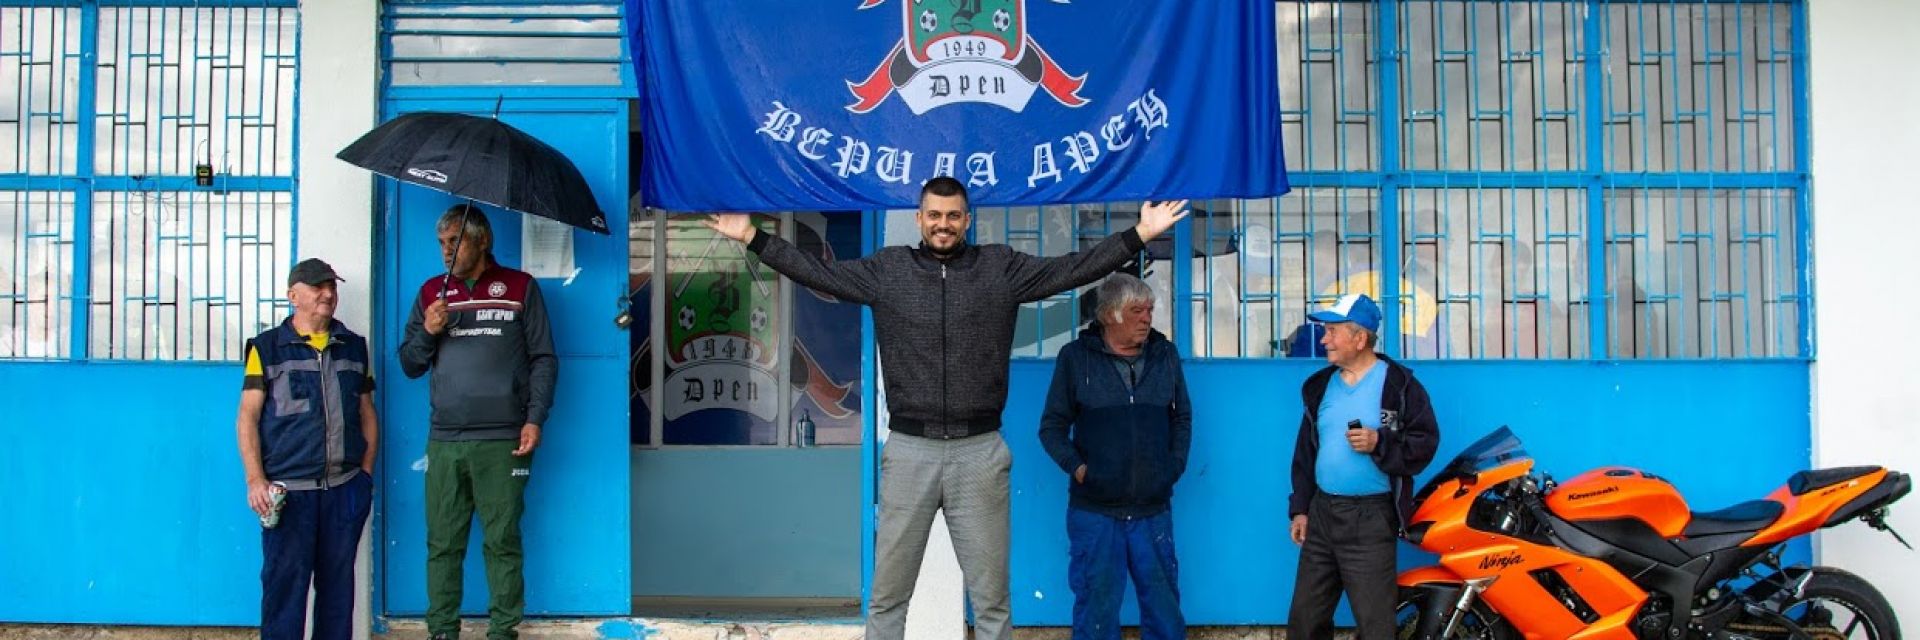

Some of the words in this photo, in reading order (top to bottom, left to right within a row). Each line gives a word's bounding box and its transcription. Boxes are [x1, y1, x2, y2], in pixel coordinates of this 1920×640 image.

[944, 40, 986, 58] 1949
[1027, 88, 1169, 187] ДРЕН
[1567, 485, 1620, 501] Kawasaki
[1478, 550, 1525, 571] Ninja
